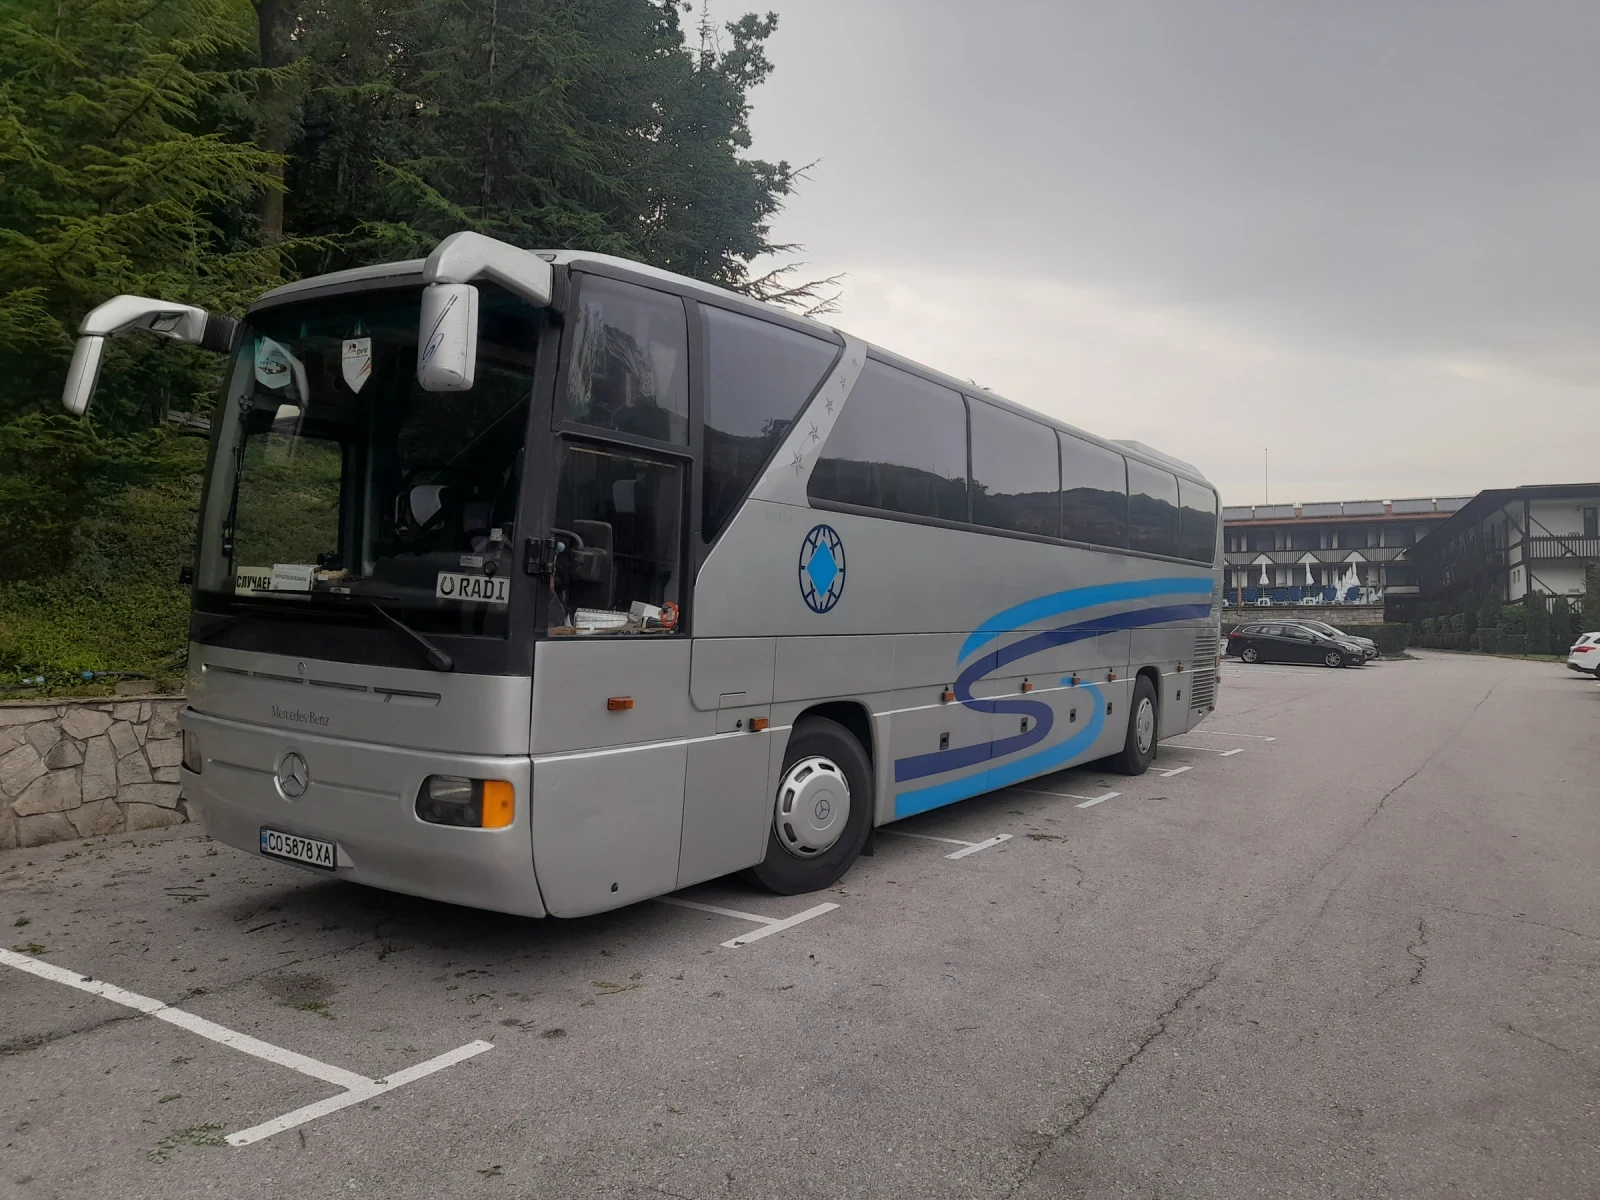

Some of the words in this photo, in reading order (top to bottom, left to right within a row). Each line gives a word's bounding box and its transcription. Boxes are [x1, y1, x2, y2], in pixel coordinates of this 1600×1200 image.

[459, 577, 505, 600] RADI
[271, 705, 330, 727] Mercedes-Benz
[285, 836, 313, 859] 5878
